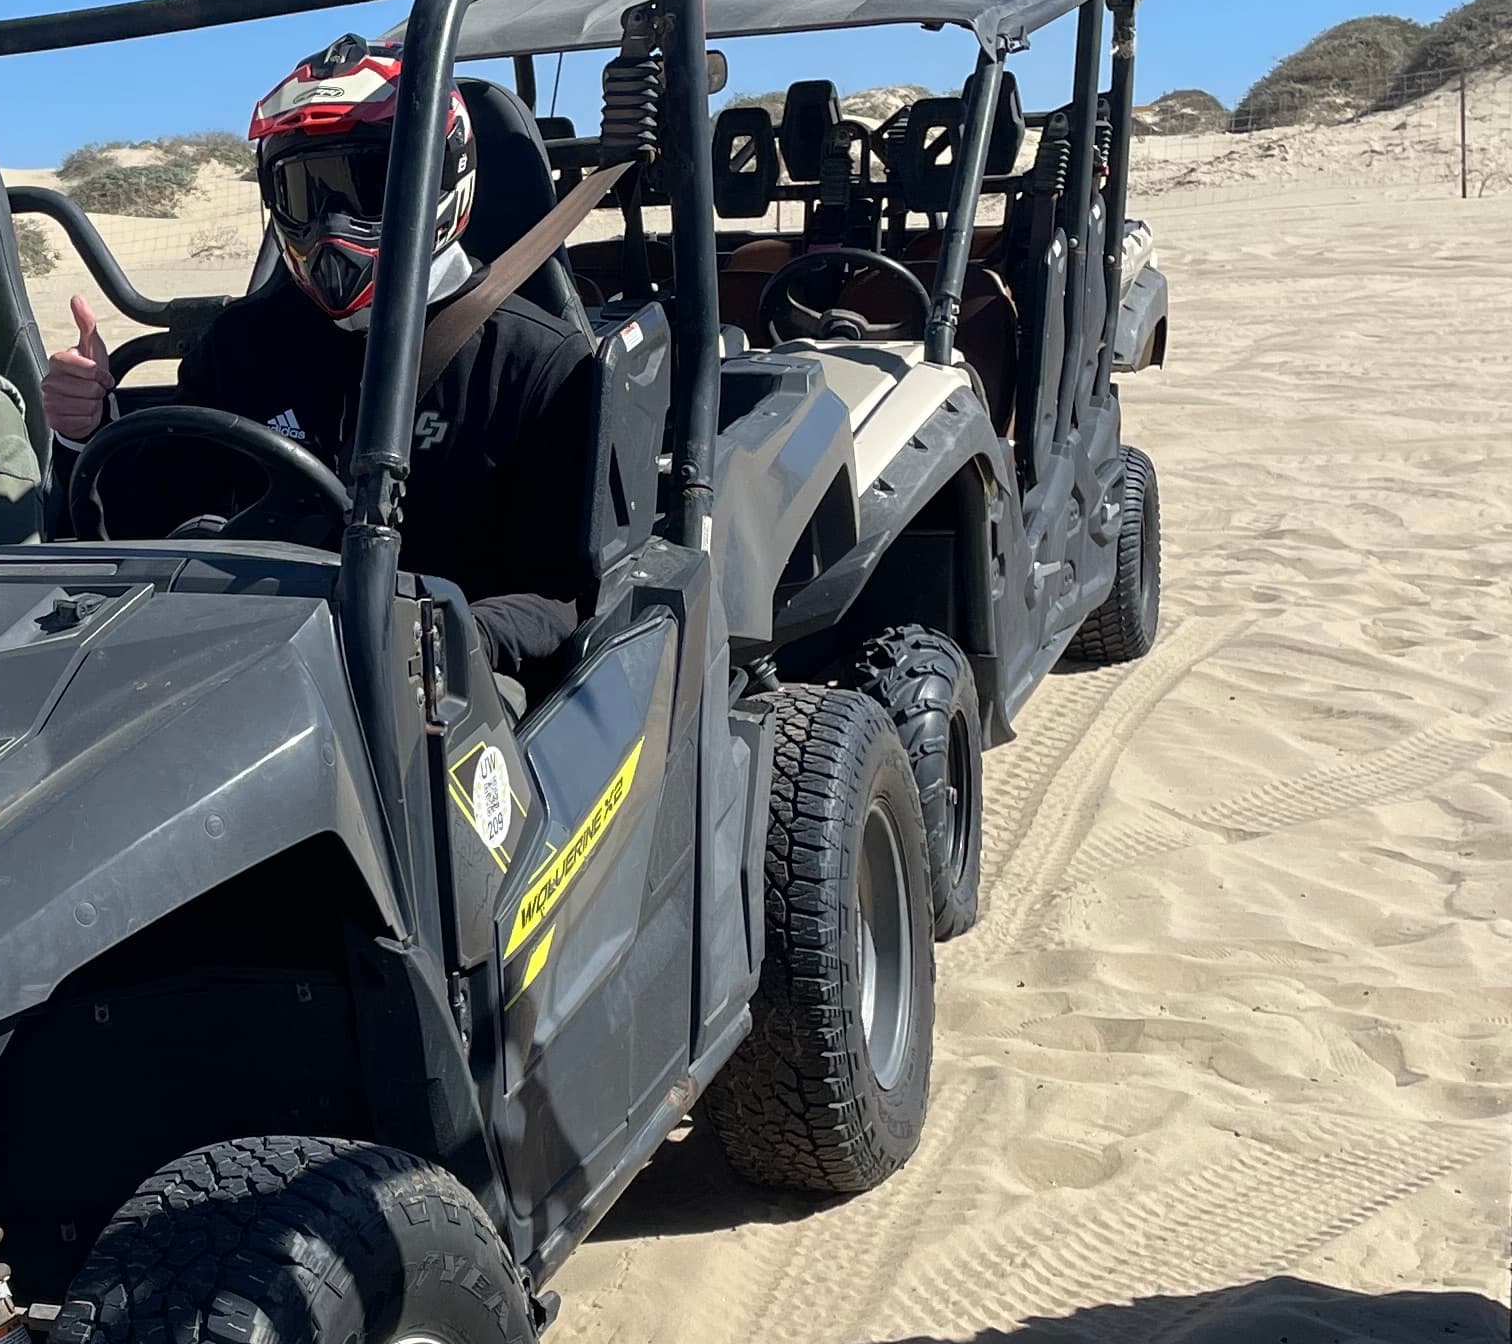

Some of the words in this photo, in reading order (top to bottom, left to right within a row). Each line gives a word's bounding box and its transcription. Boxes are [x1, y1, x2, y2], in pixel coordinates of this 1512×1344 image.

[264, 423, 306, 440] didas
[520, 807, 603, 929] WOLVERINE
[603, 776, 624, 823] X2
